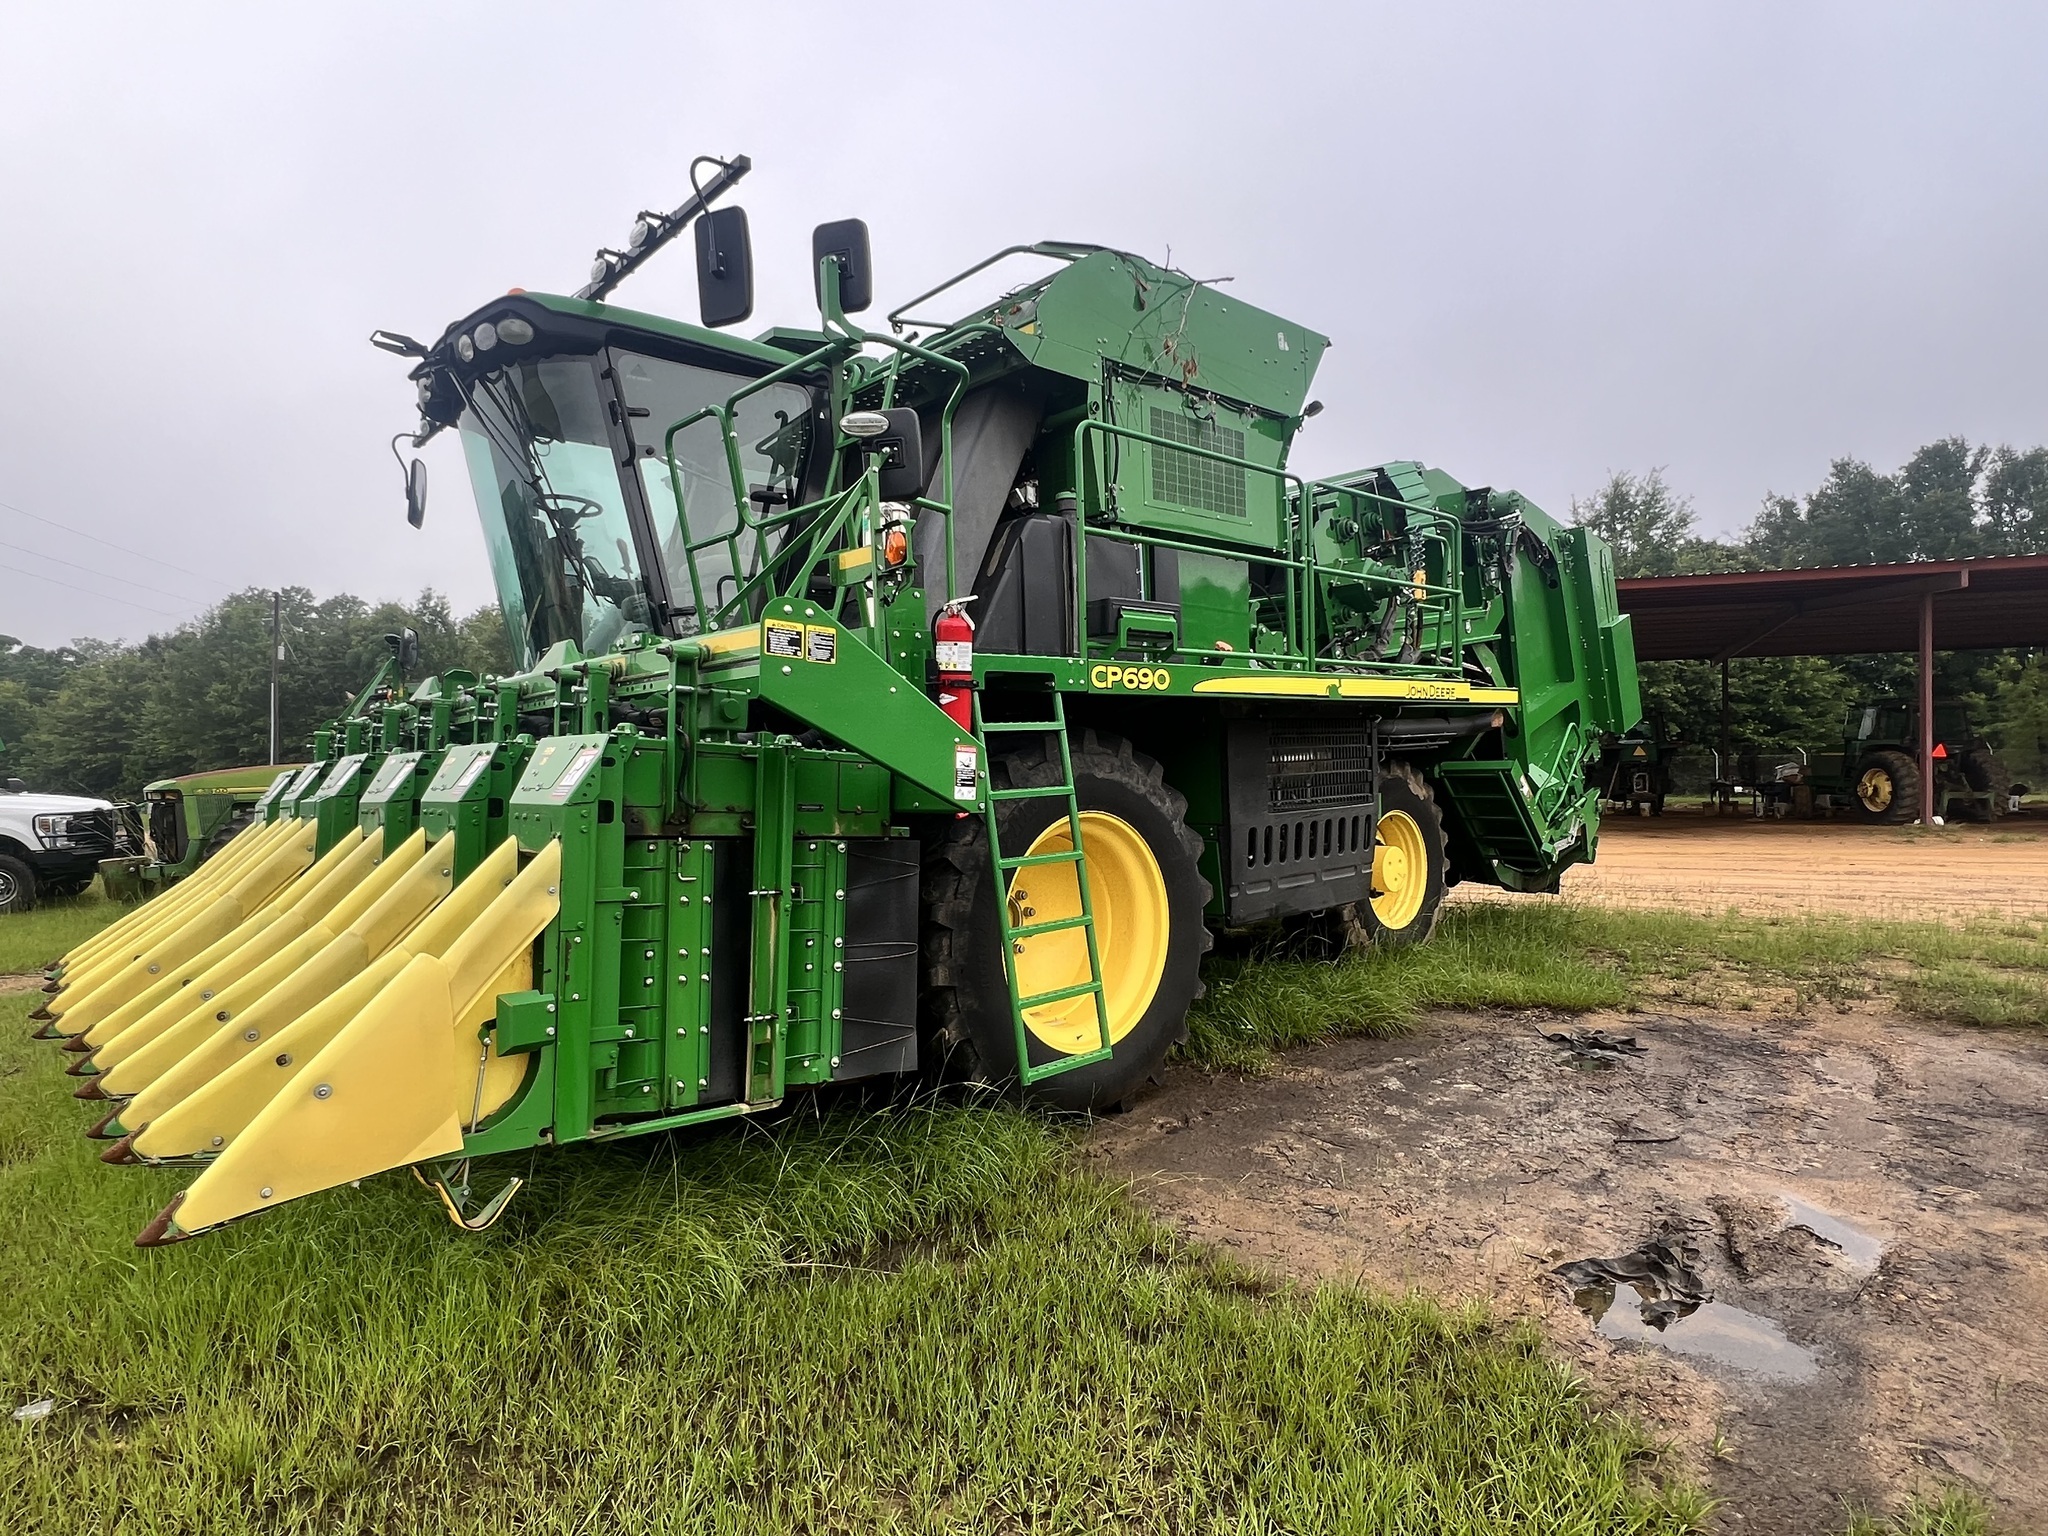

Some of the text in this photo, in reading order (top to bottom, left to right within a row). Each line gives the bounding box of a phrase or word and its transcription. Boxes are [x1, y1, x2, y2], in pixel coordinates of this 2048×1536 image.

[1090, 664, 1171, 691] CP690
[1405, 684, 1457, 699] JOHN DEERE
